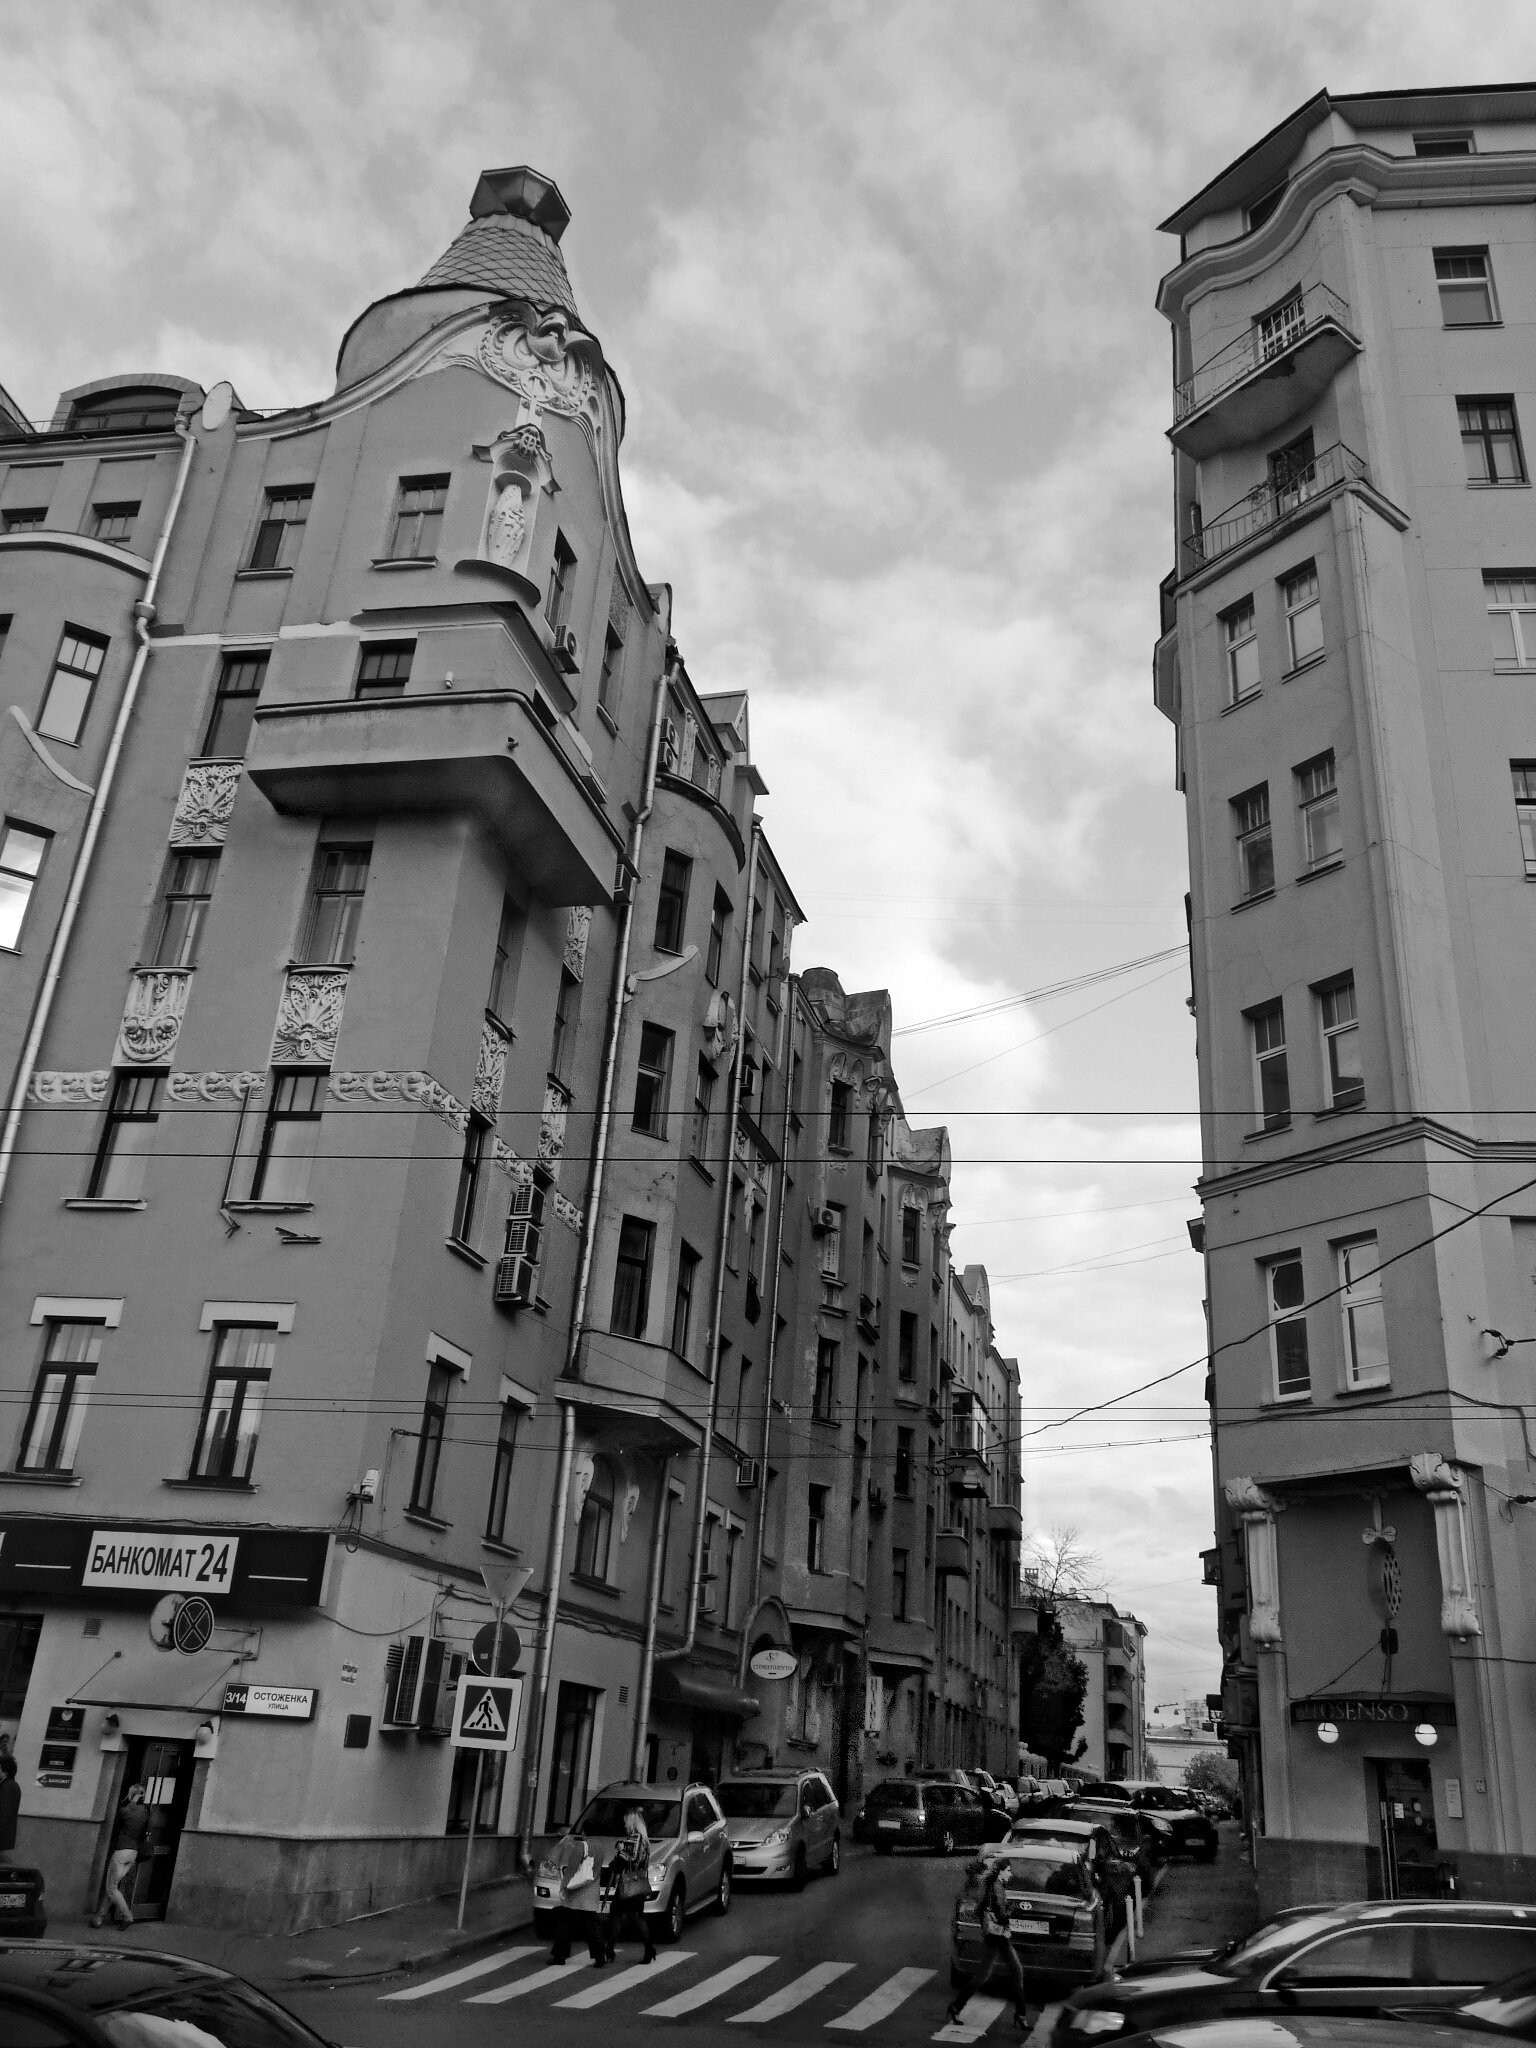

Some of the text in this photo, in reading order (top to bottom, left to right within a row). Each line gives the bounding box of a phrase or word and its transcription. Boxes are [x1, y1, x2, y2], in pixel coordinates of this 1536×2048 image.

[90, 1543, 230, 1583] БАНКОМАТ 24
[225, 1692, 247, 1704] 3/14
[253, 1692, 308, 1704] ОСТОЖЕНКА
